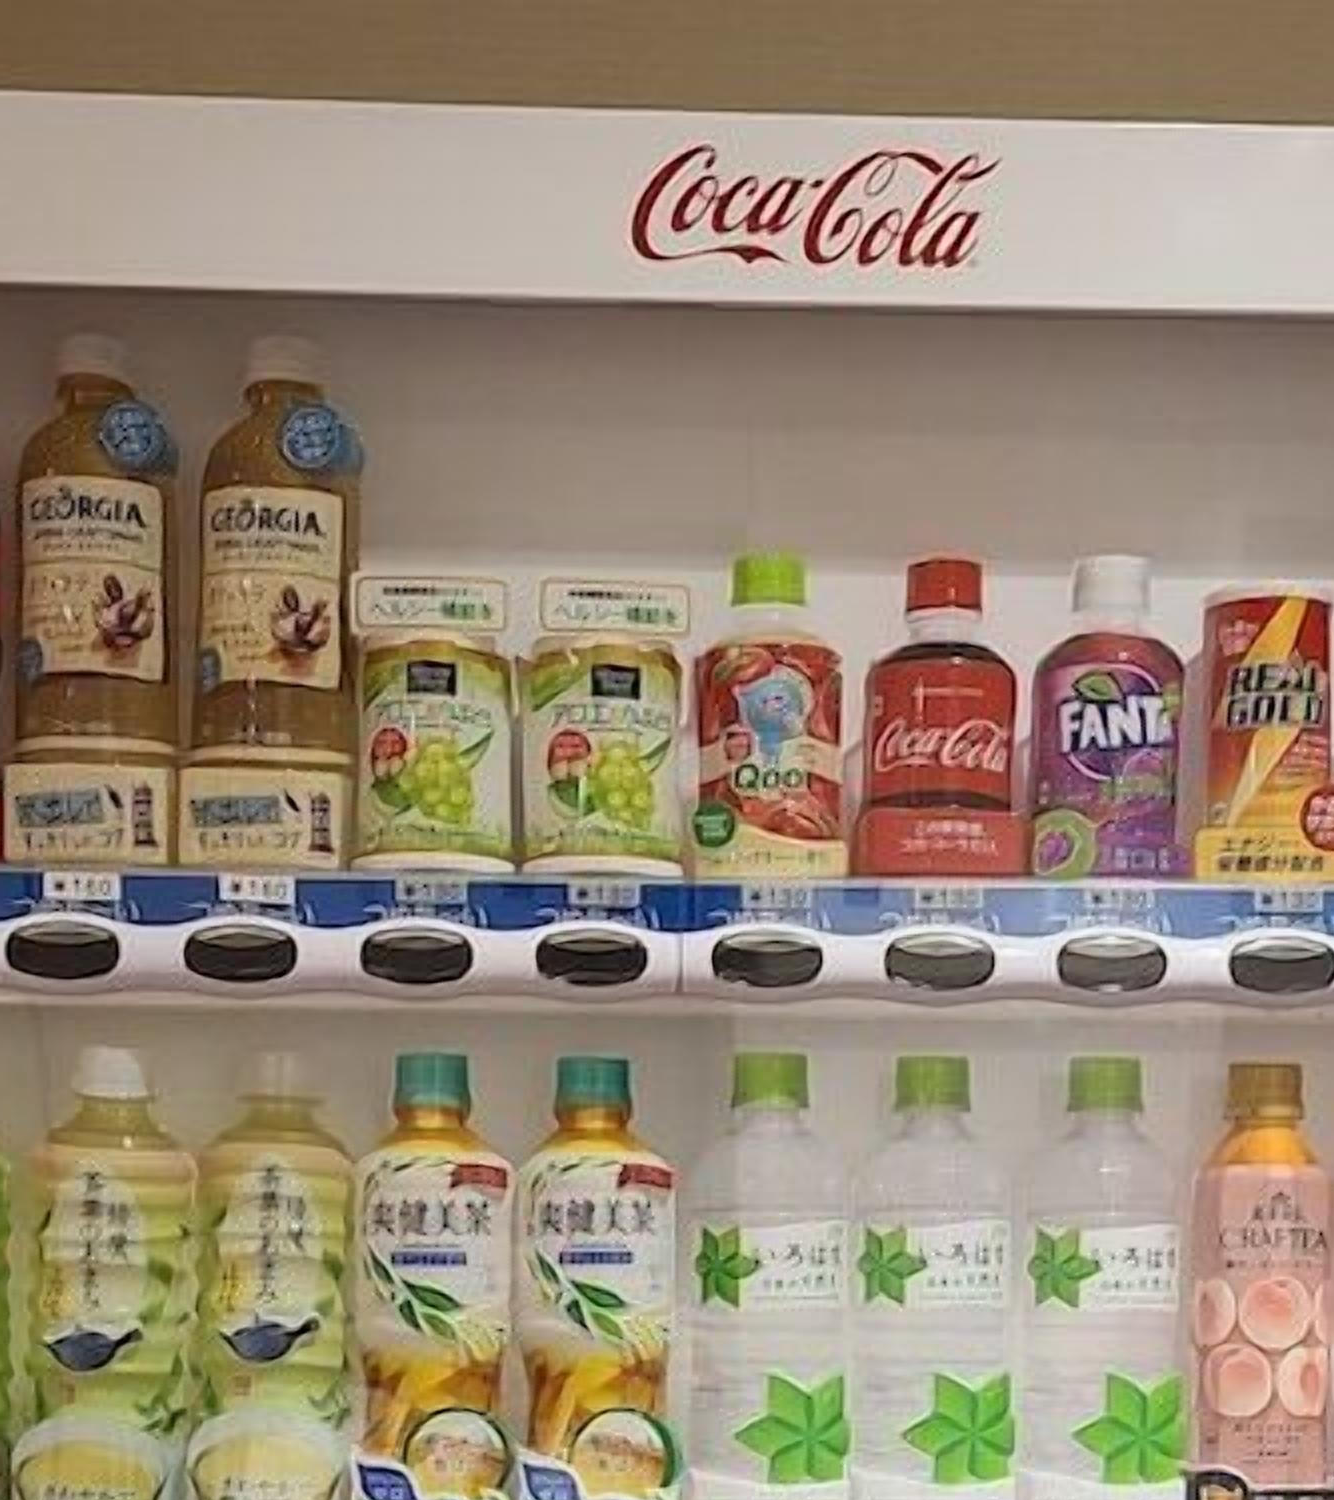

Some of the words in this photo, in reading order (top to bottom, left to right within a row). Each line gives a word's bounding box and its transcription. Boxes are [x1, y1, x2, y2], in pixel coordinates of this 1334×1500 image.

[630, 143, 1003, 268] Coca-Cola
[30, 487, 148, 528] GEORGIA
[210, 496, 326, 538] GEORGIA
[1229, 664, 1319, 692] REAL
[1226, 696, 1323, 728] GOLD
[734, 762, 805, 793] Qoo
